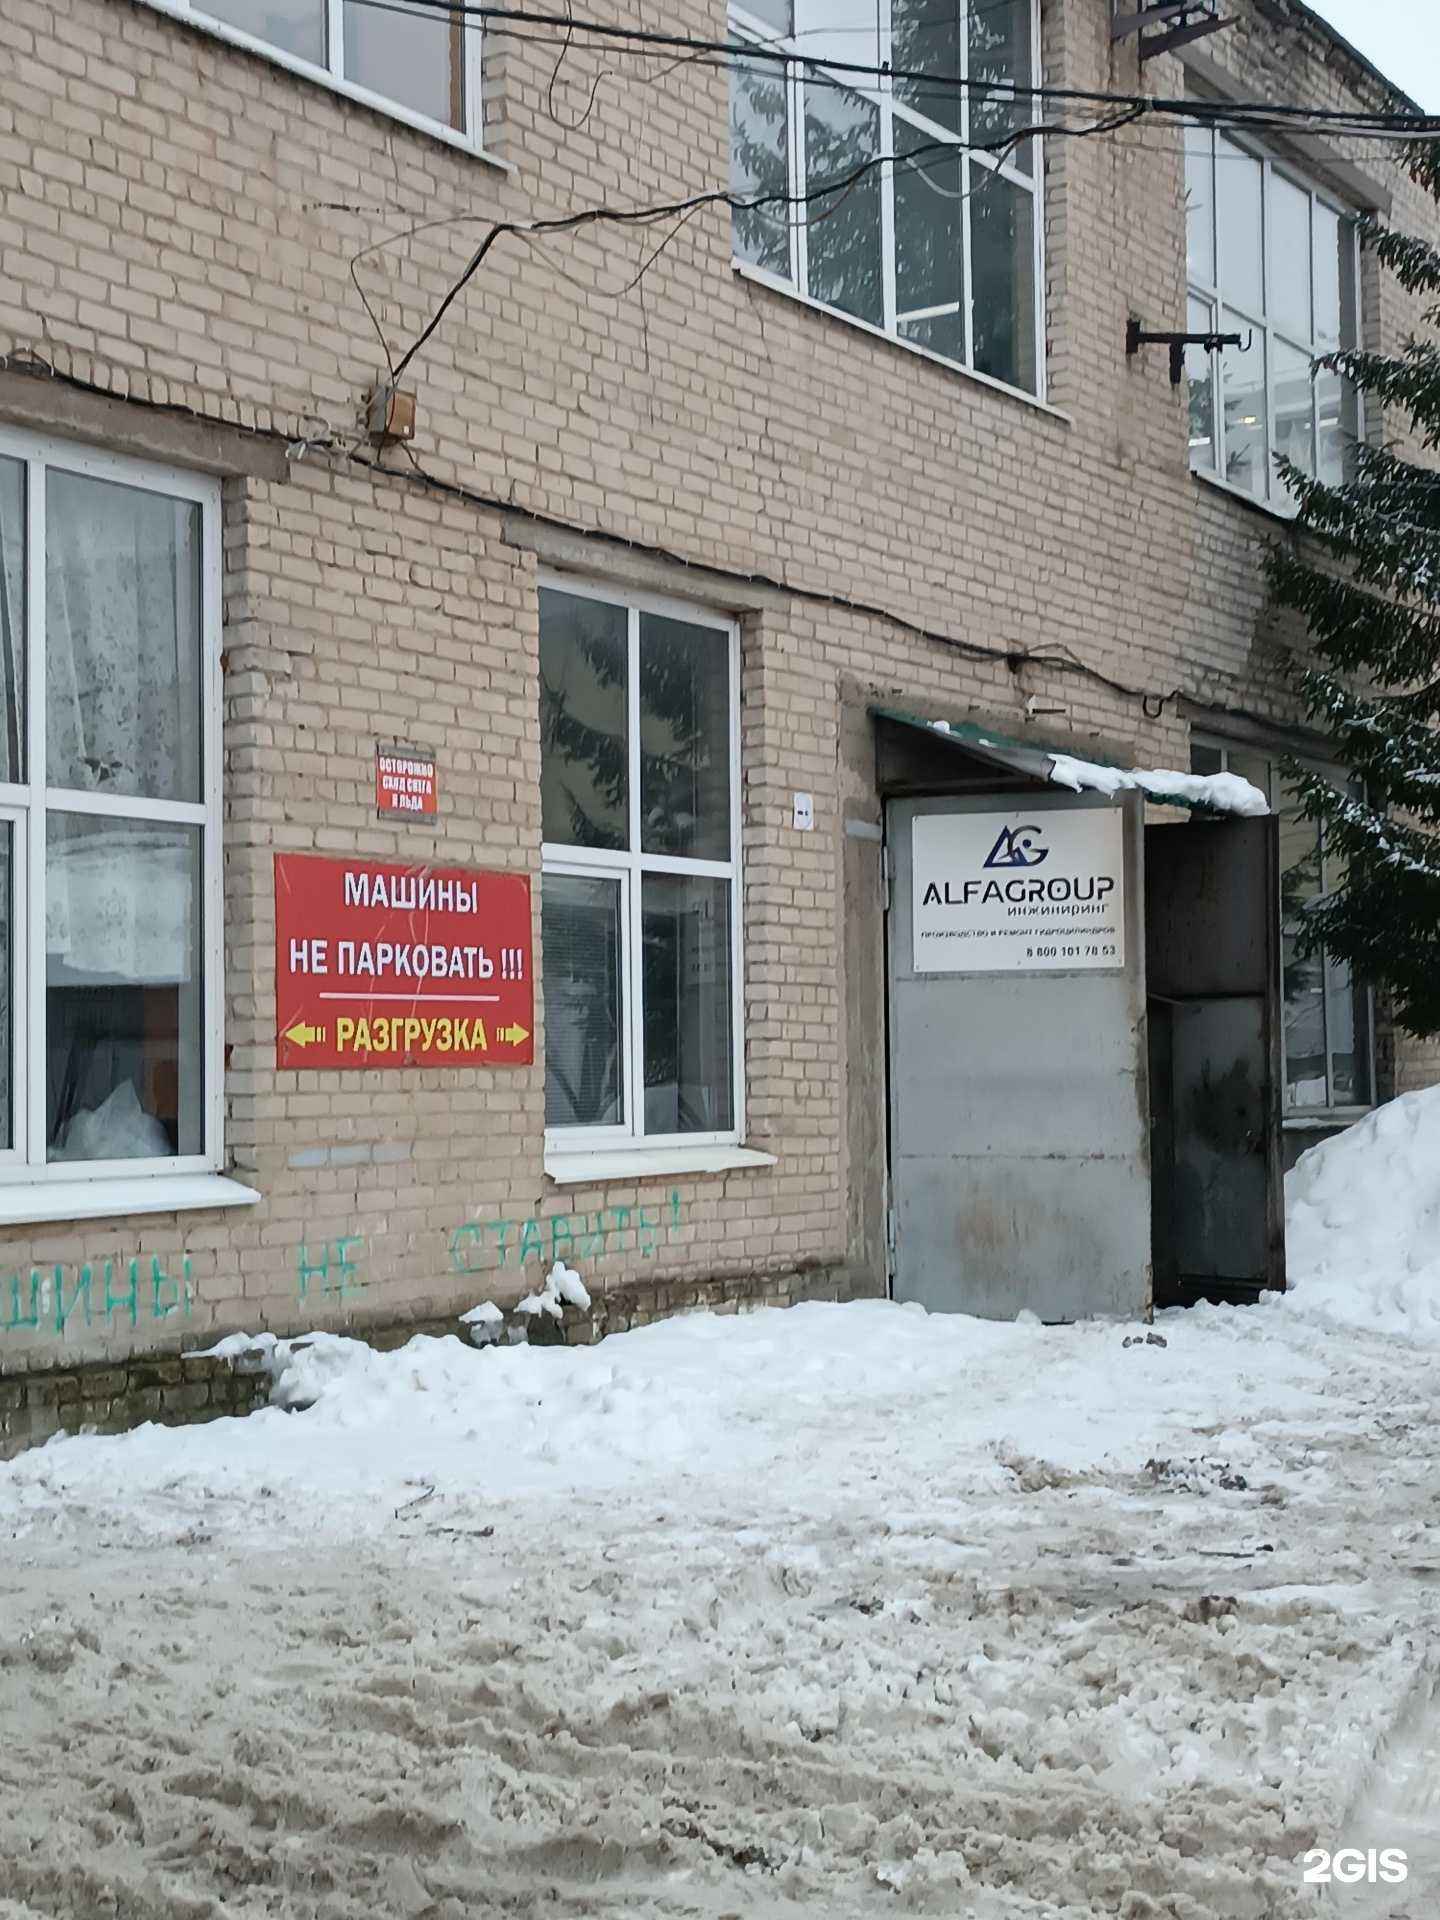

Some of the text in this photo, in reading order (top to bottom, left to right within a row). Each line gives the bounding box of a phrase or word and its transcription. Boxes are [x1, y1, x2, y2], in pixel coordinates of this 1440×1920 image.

[380, 757, 433, 778] ОСТОРОЖНО
[344, 872, 478, 914] МАШИНЫ
[922, 876, 1114, 906] ALFAGROUP
[290, 938, 523, 980] НЕ ПАРКОВАТЬ !!!
[1061, 945, 1080, 957] 101
[336, 1017, 488, 1051] РАЗГРУЗКА
[298, 1235, 364, 1302] НЕ
